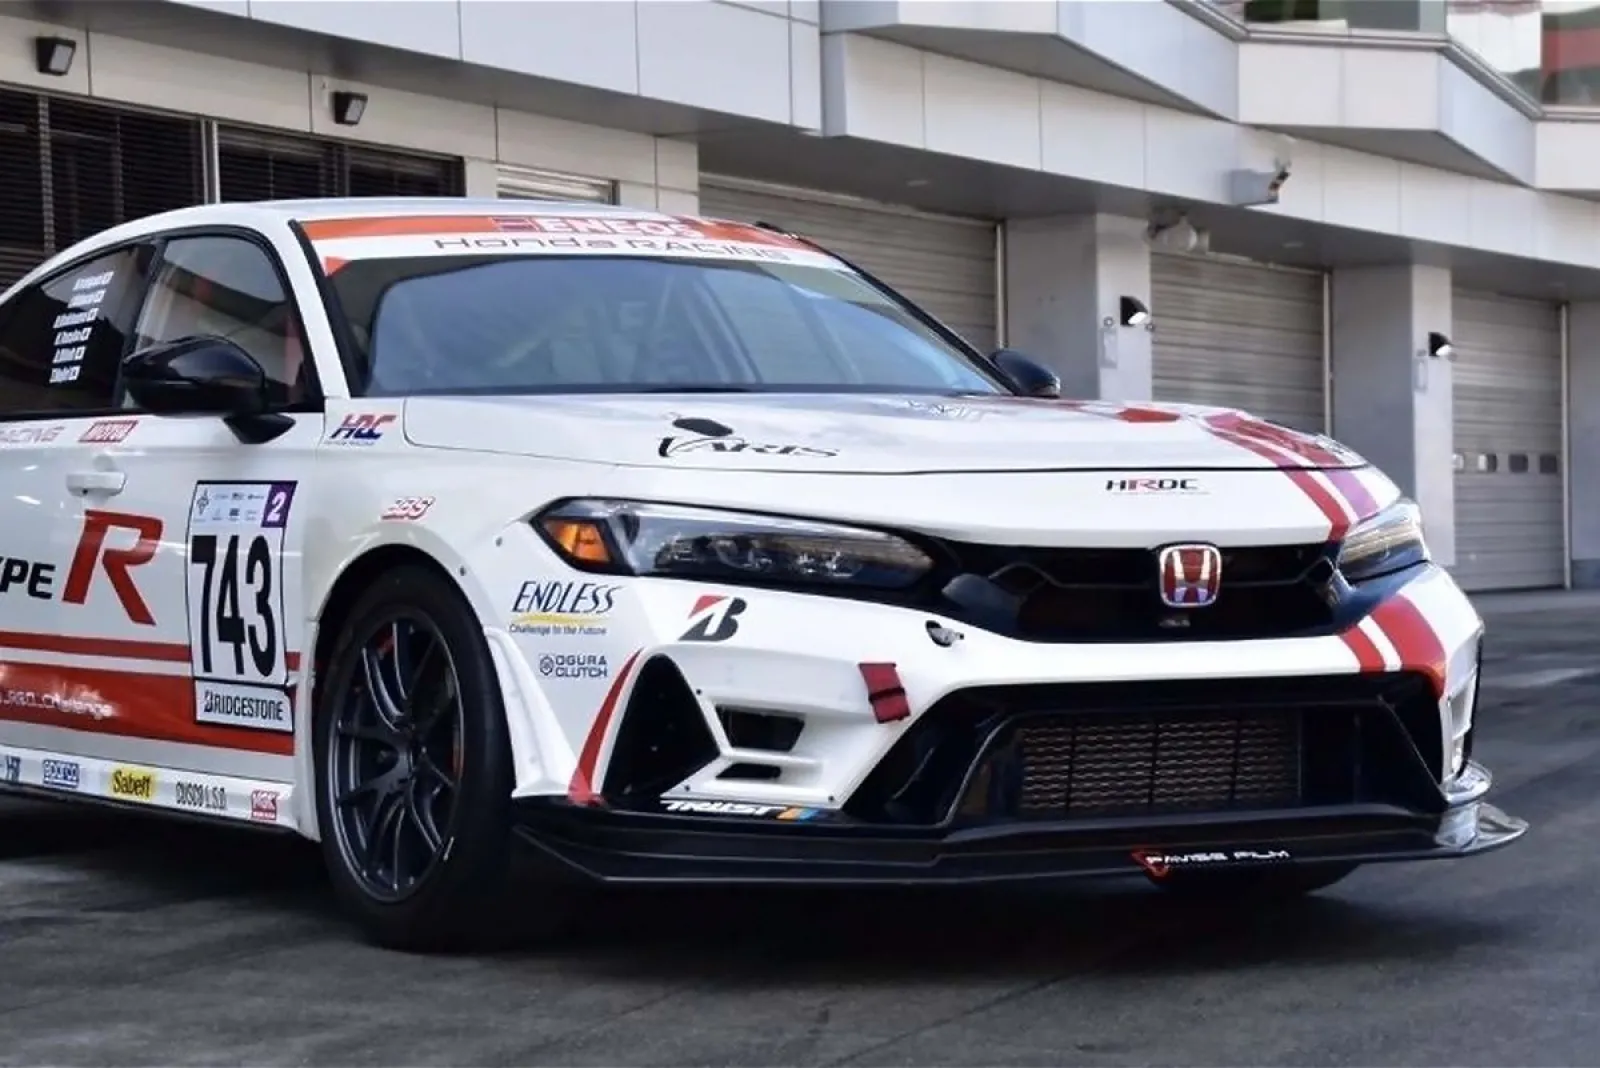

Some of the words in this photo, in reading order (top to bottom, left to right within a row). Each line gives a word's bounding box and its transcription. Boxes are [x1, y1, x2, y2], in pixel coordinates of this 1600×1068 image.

[434, 237, 617, 249] Honda
[266, 491, 287, 522] 2
[62, 509, 163, 626] R
[191, 535, 276, 677] 743
[511, 580, 627, 614] ENDLESS
[555, 655, 607, 666] OGURA
[555, 666, 608, 678] CLUTCH
[204, 690, 284, 721] BRIDGESTONE
